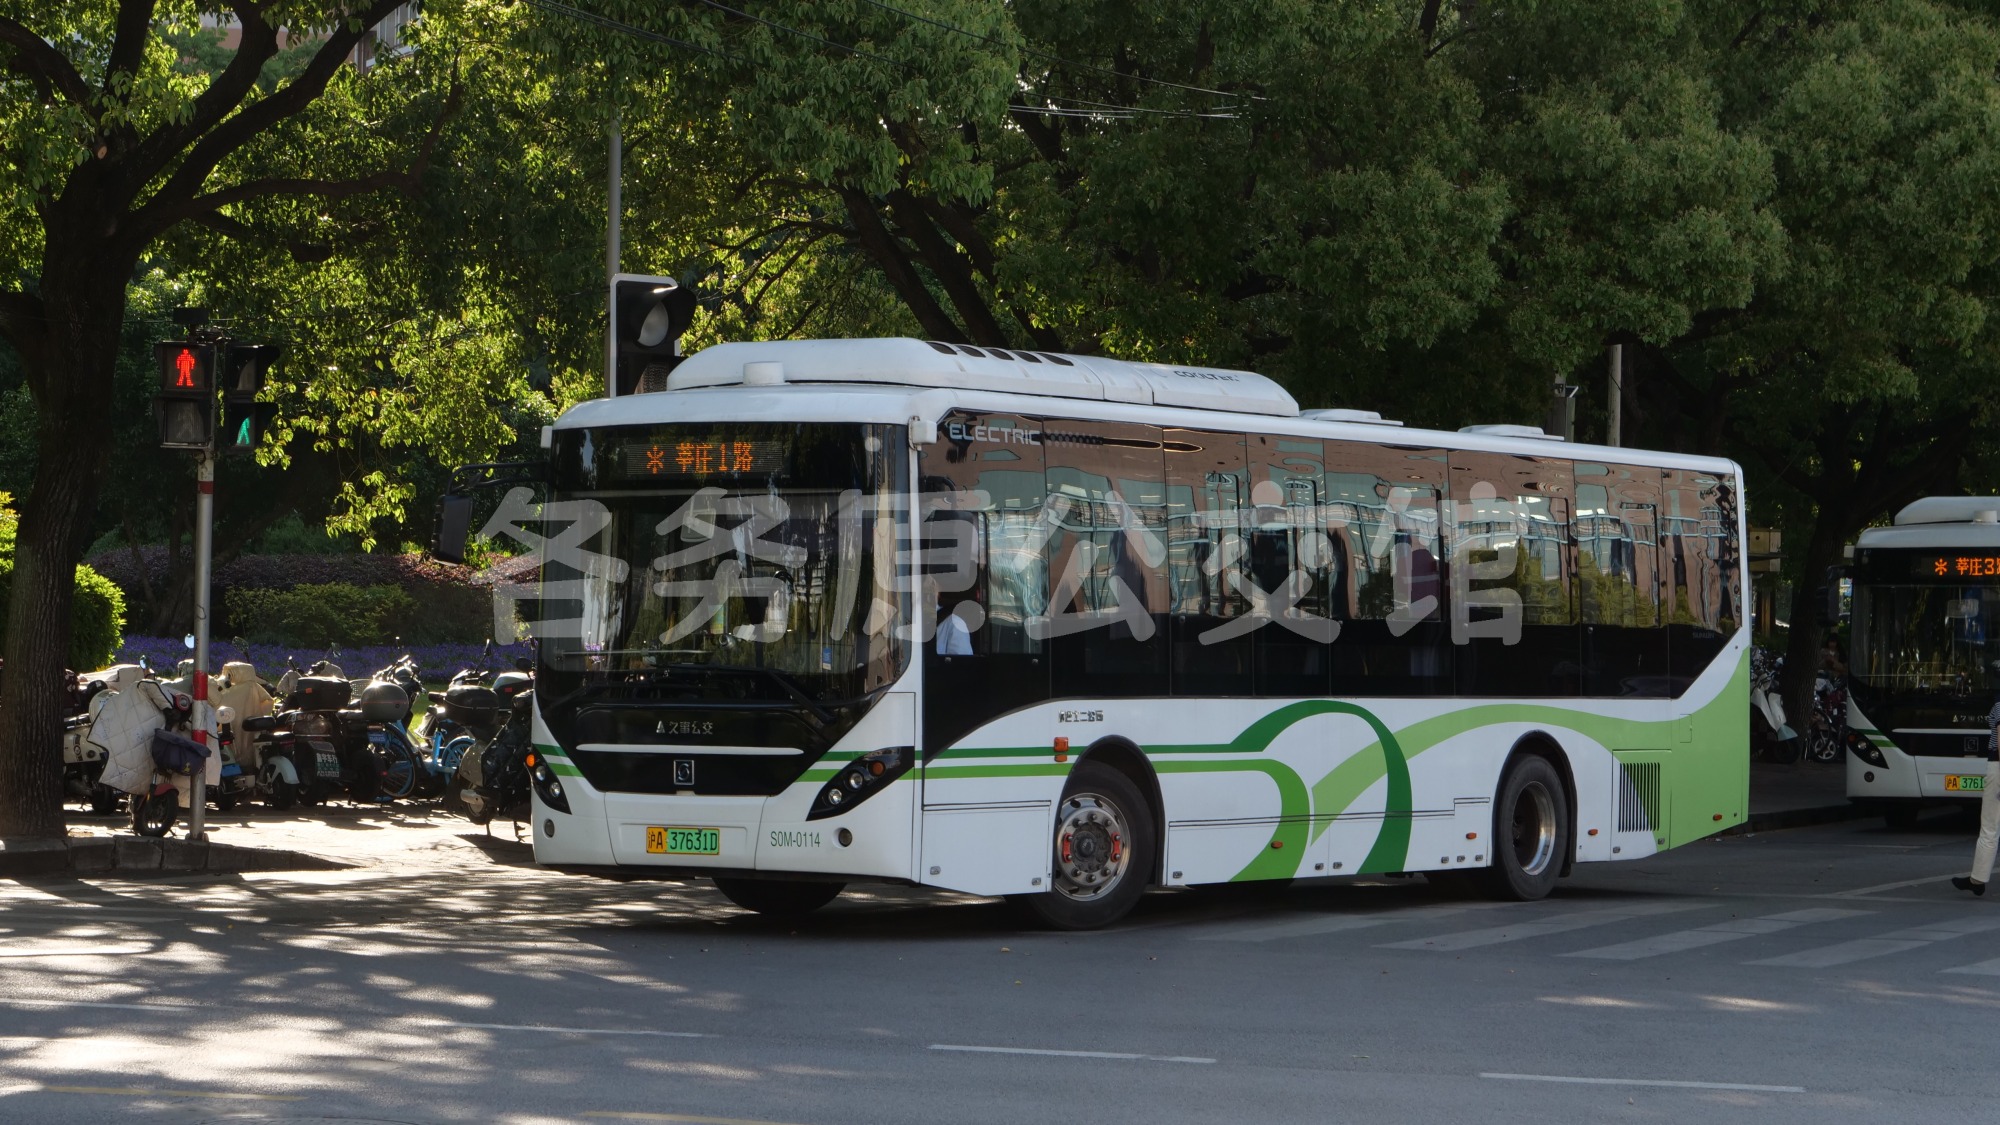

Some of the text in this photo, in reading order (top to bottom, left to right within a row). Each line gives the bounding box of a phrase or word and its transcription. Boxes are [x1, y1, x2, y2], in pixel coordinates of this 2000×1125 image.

[950, 423, 1042, 446] ELECTRIC
[676, 442, 753, 474] 莘庄1路
[668, 721, 713, 735] 久事公交
